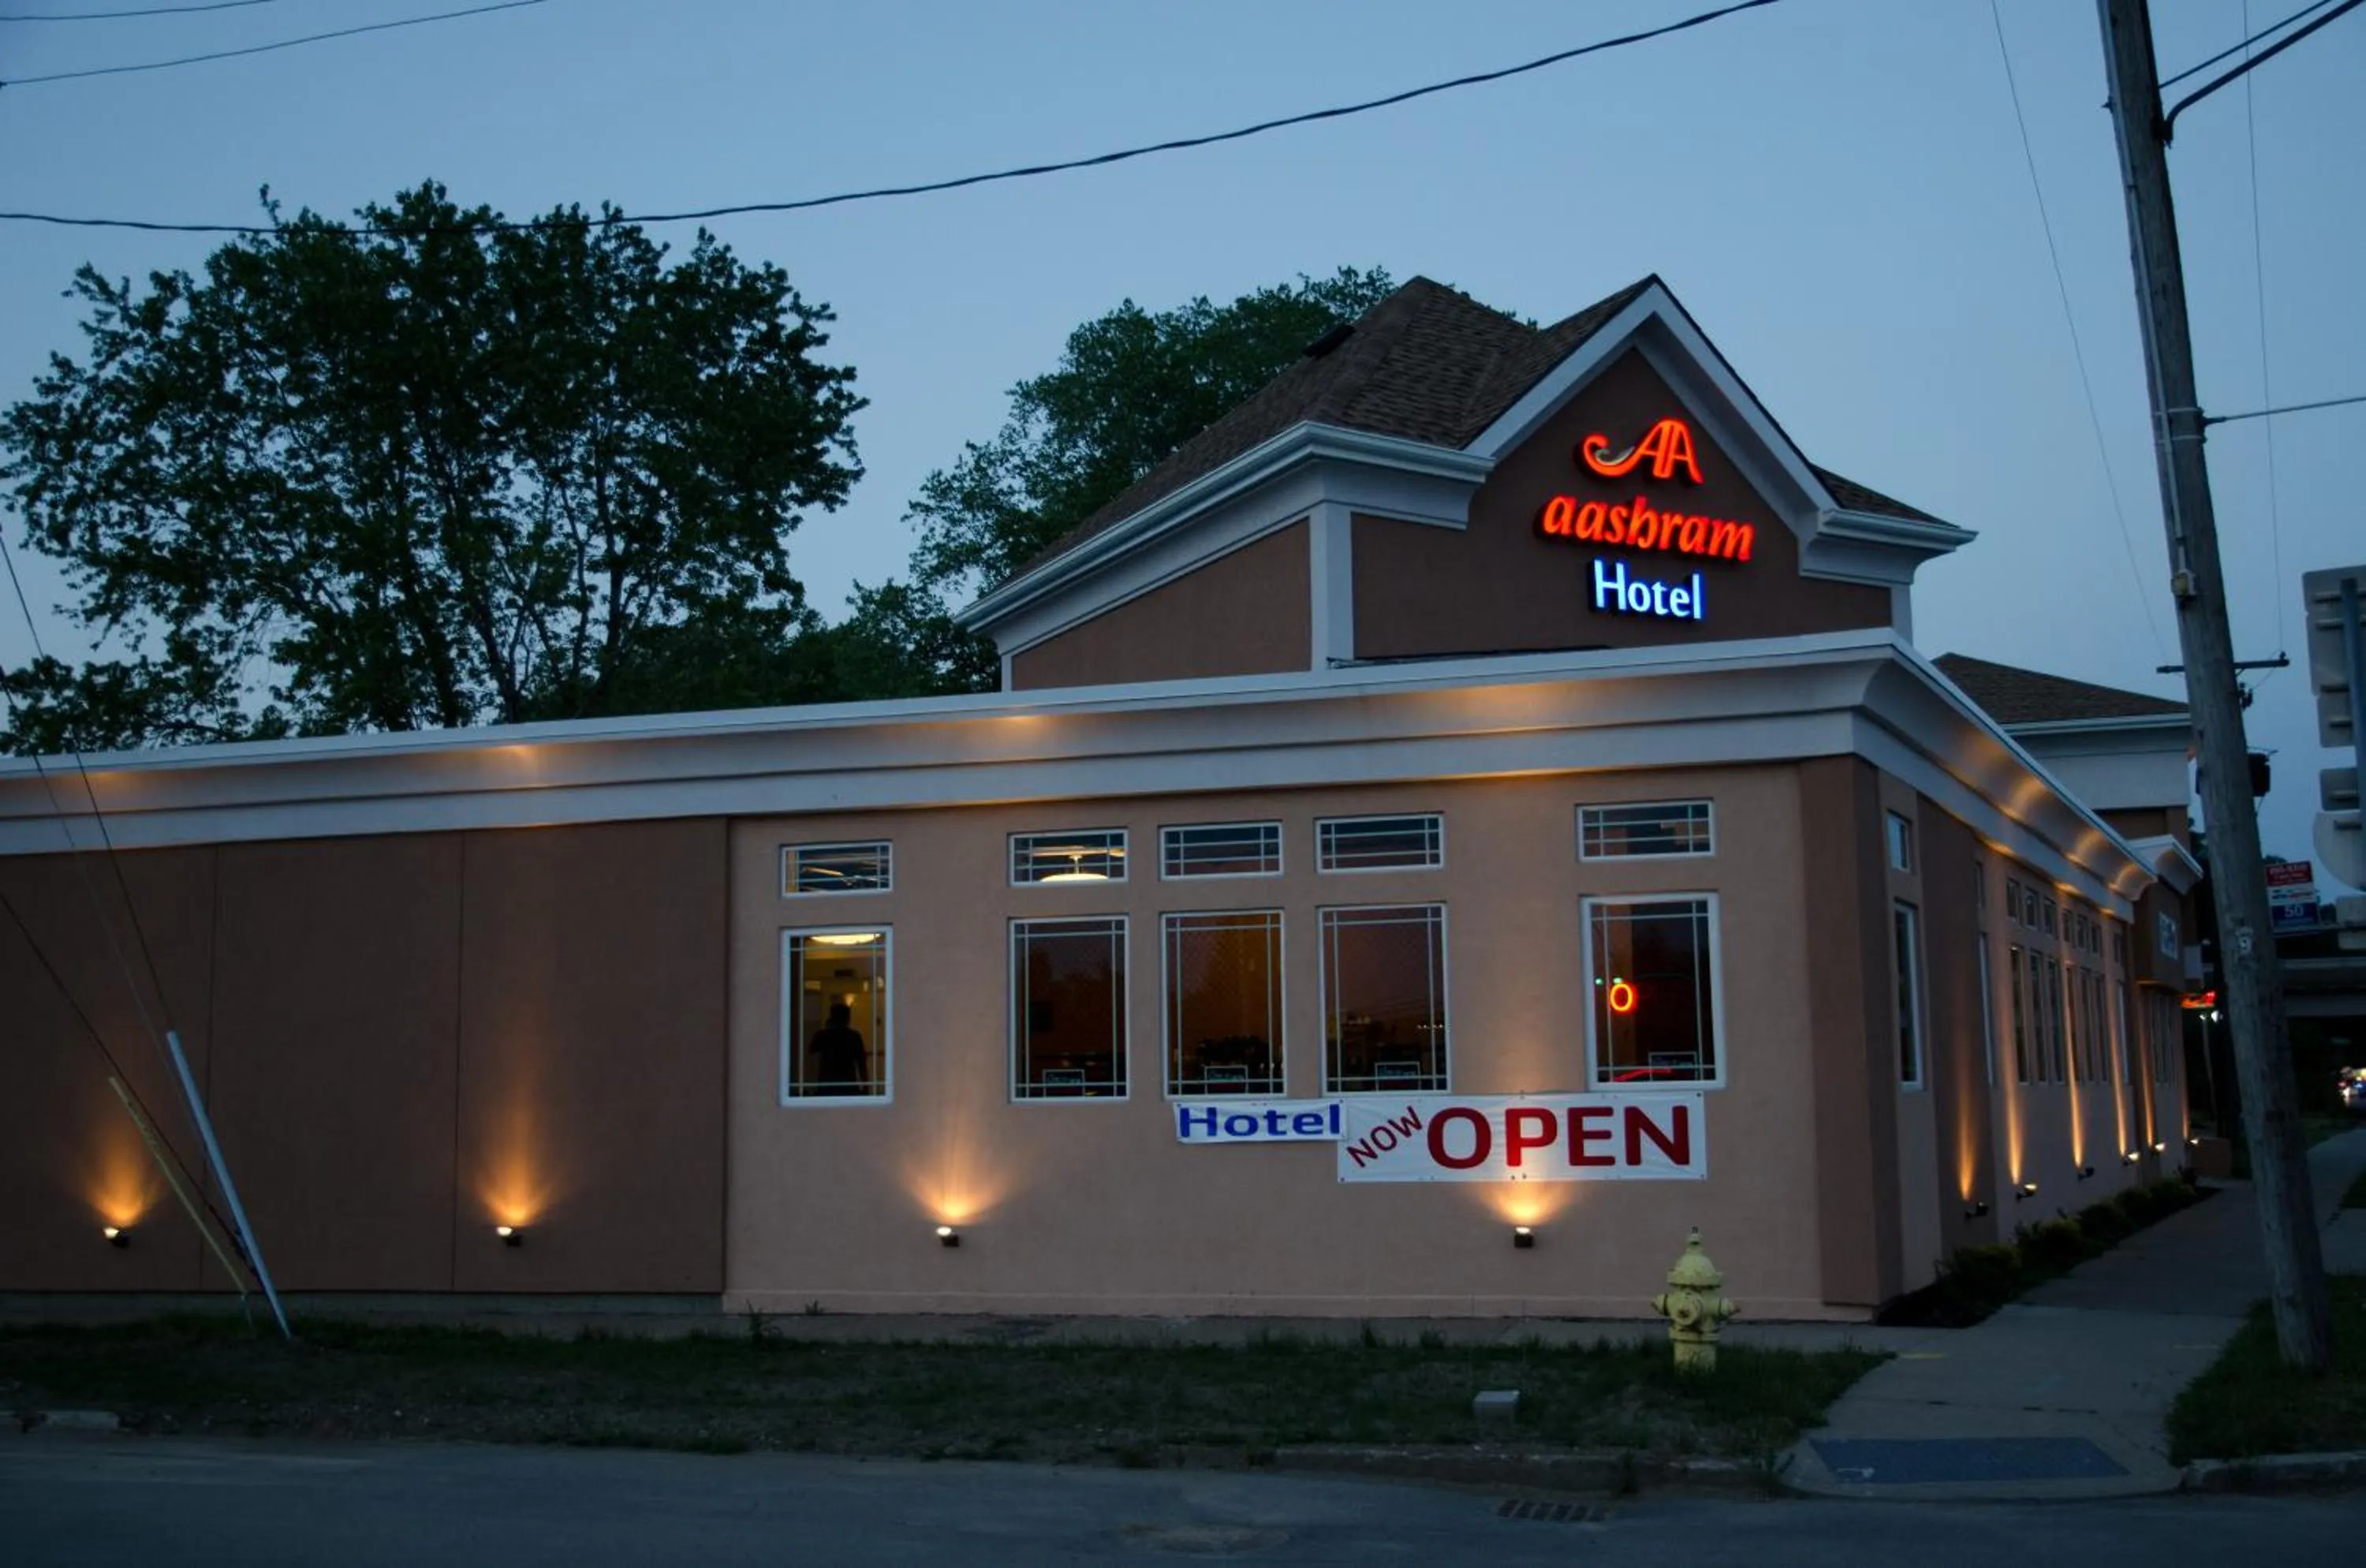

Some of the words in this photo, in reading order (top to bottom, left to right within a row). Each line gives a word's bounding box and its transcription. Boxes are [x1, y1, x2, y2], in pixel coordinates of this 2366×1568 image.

[1593, 558, 1702, 619] Hotel
[1179, 1103, 1340, 1137] Hotel
[1345, 1105, 1424, 1168] NOW
[1427, 1106, 1691, 1170] OPEN
